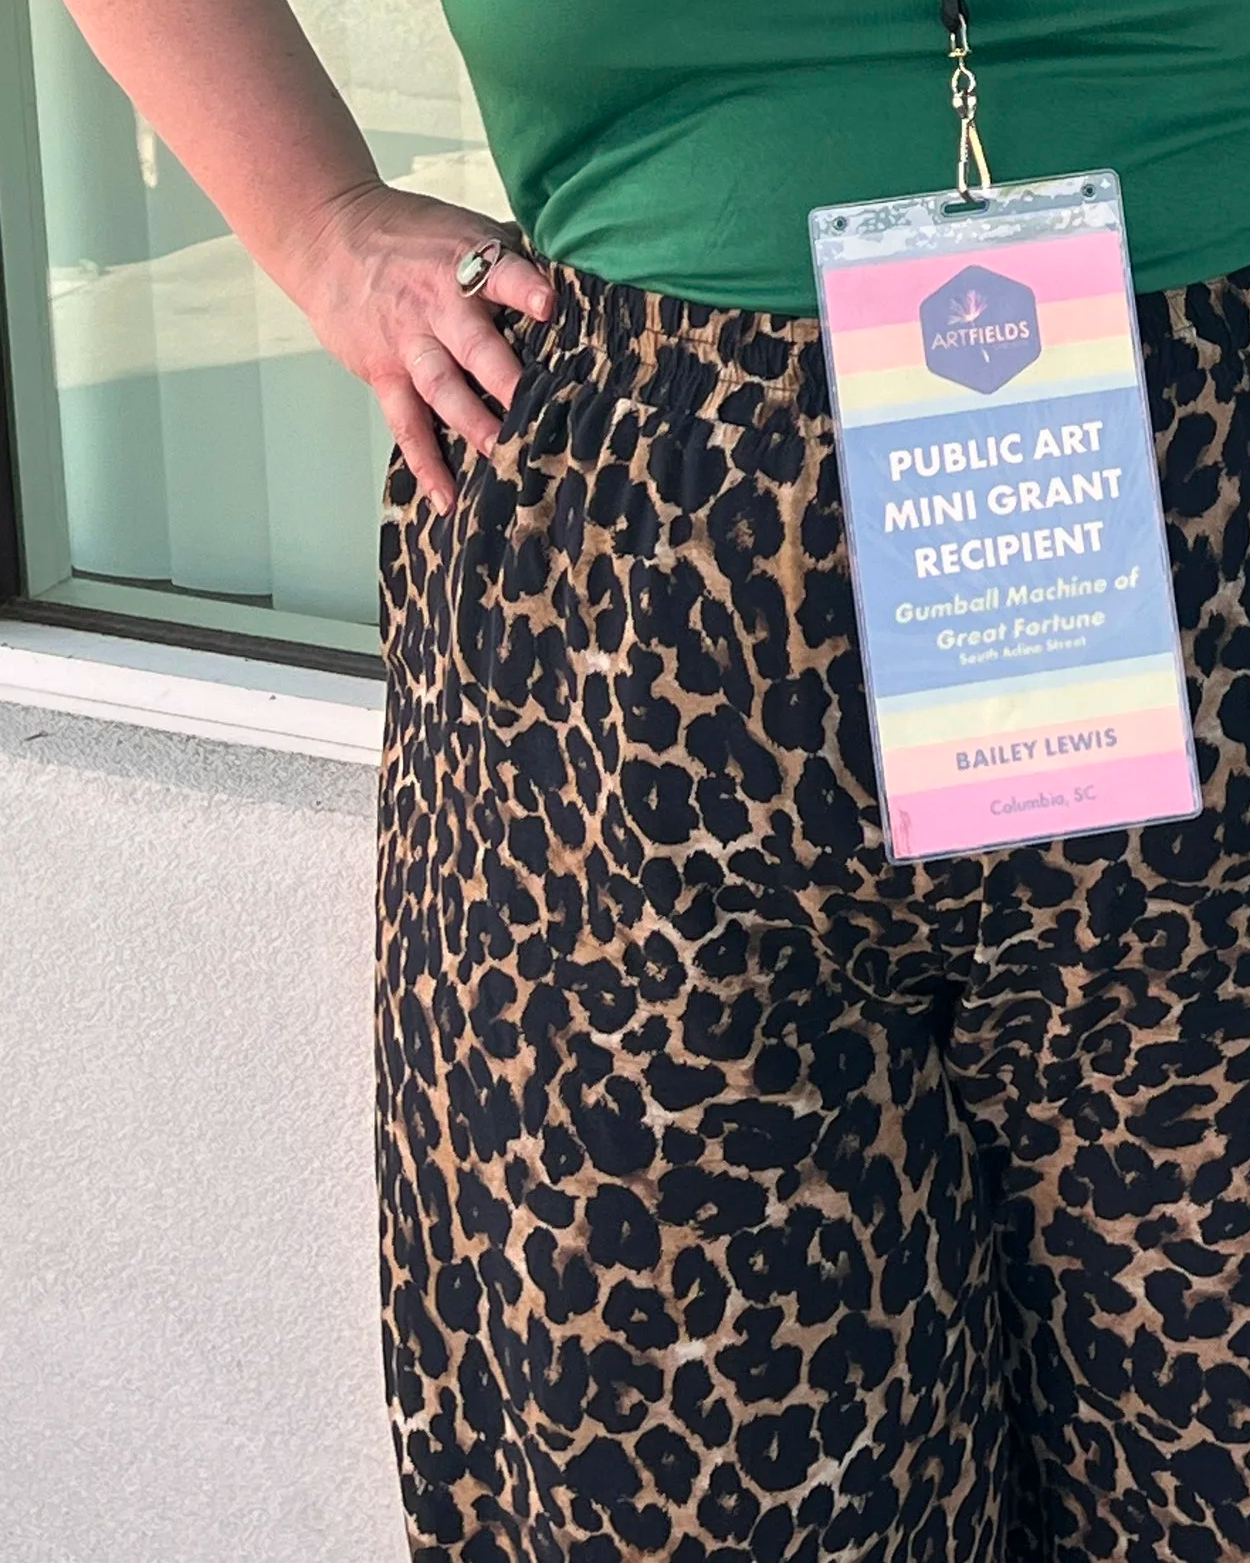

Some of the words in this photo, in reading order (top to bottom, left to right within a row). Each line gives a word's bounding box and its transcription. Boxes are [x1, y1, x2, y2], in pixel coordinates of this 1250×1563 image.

[930, 320, 1030, 350] ARTFIELDS
[889, 433, 1024, 482] PUBLIC
[1033, 421, 1103, 460] ART
[884, 489, 977, 533] MINI
[987, 468, 1122, 516] GRANT
[915, 521, 1104, 578] RECIPIENT
[896, 587, 999, 623] Gumball
[1006, 577, 1107, 607] Machine
[1114, 566, 1140, 590] of
[936, 622, 1007, 650] Great
[1013, 611, 1106, 639] Fortune
[959, 648, 998, 666] South
[1046, 636, 1086, 652] Street
[956, 740, 1037, 771] BAILEY
[1045, 728, 1118, 756] LEWIS
[990, 791, 1069, 815] Columbia,
[1074, 785, 1096, 804] SC
